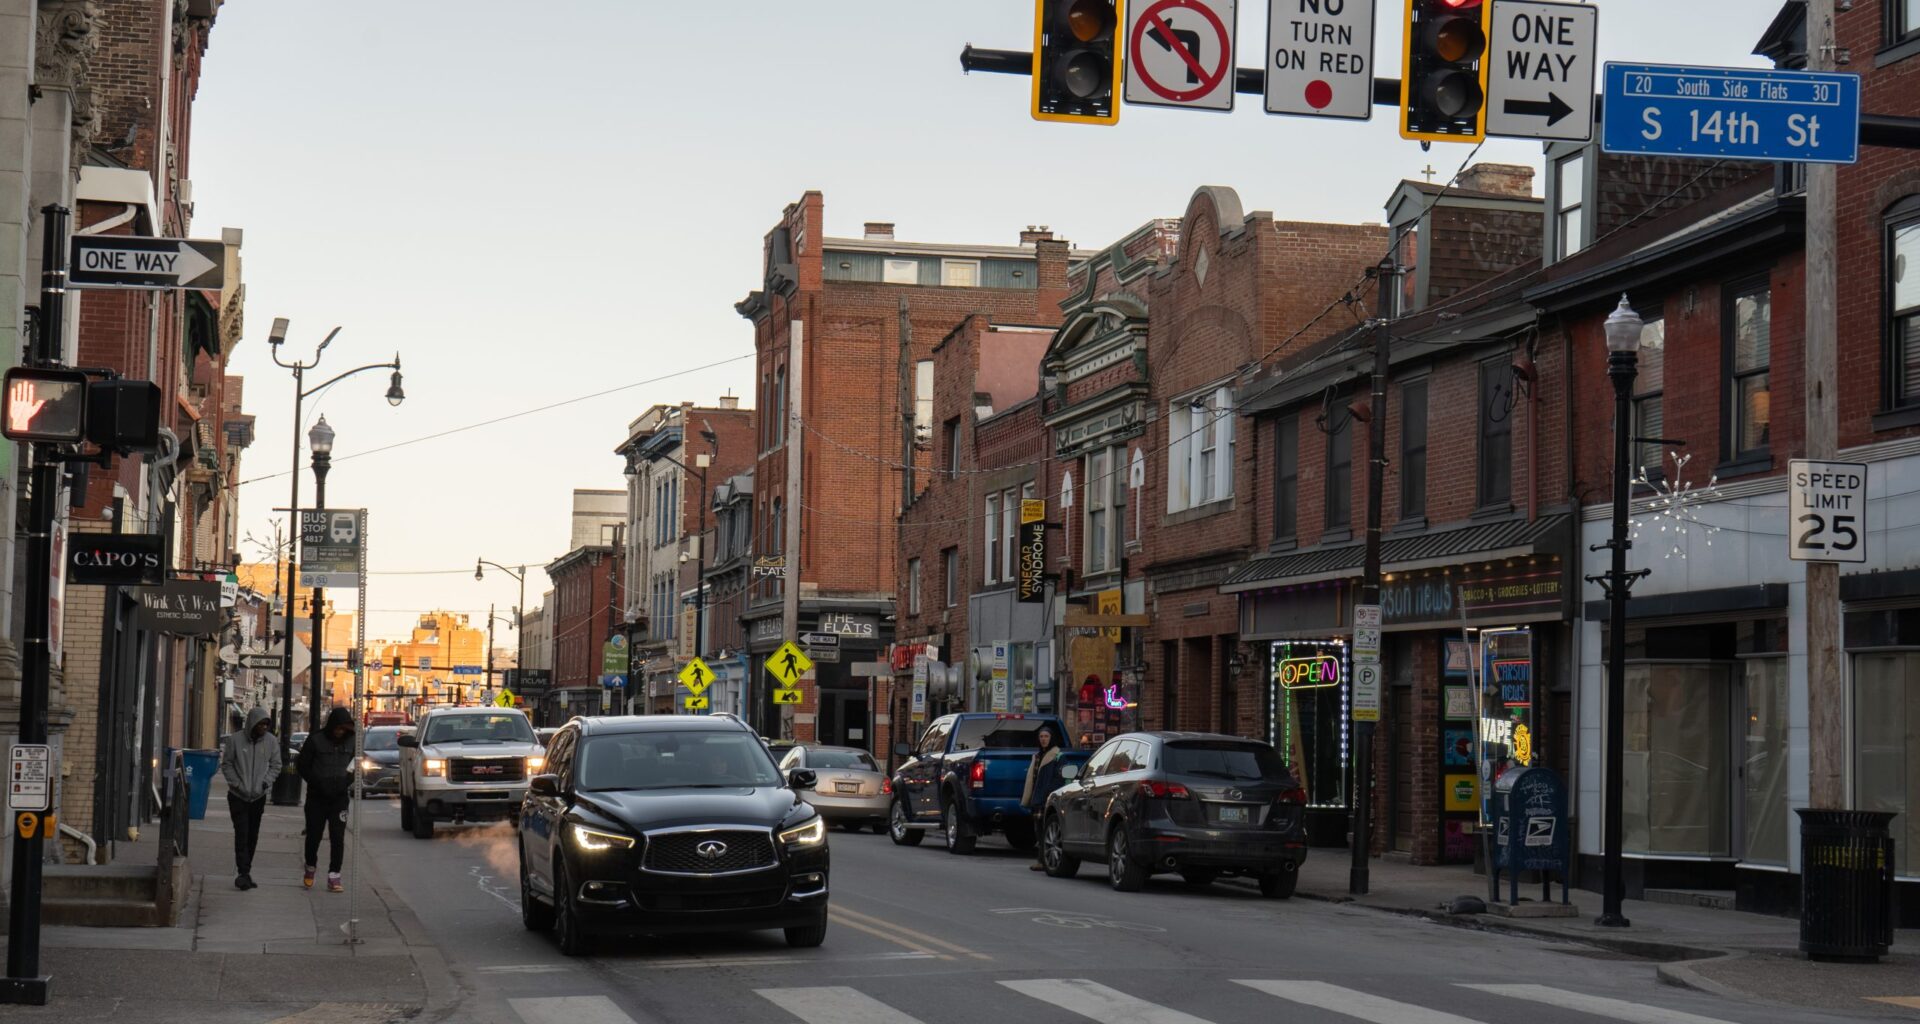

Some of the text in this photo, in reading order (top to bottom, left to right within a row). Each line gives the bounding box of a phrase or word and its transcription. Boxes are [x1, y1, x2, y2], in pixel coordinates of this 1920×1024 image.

[1300, 0, 1344, 15] NO
[1290, 21, 1353, 46] TURN
[1511, 13, 1575, 46] ONE
[1274, 48, 1364, 75] ON RED
[1506, 50, 1576, 83] WAY
[1635, 76, 1829, 102] 20 South Side Flats 30
[1641, 106, 1821, 148] S 14th St
[85, 251, 179, 273] ONE WAY
[1796, 473, 1861, 490] SPEED
[1803, 493, 1852, 510] LIMIT
[303, 513, 327, 523] BUS
[303, 524, 327, 533] STOP
[1797, 514, 1858, 551] 25
[304, 535, 324, 543] 4817
[73, 551, 159, 568] CAPO'S
[1032, 523, 1044, 593] SYNDROME
[1021, 545, 1032, 600] VINEGAR
[1463, 589, 1484, 601] OBACCO
[1497, 586, 1529, 598] GROCERIES
[1532, 581, 1558, 595] LOTTERY
[143, 593, 169, 609] Wink
[192, 595, 217, 612] Wax
[182, 612, 202, 620] STUDIO
[827, 613, 855, 624] THE
[824, 623, 873, 634] FLATS
[1283, 661, 1336, 683] OPEN
[1481, 717, 1512, 745] VAPE
[472, 765, 504, 775] GMC
